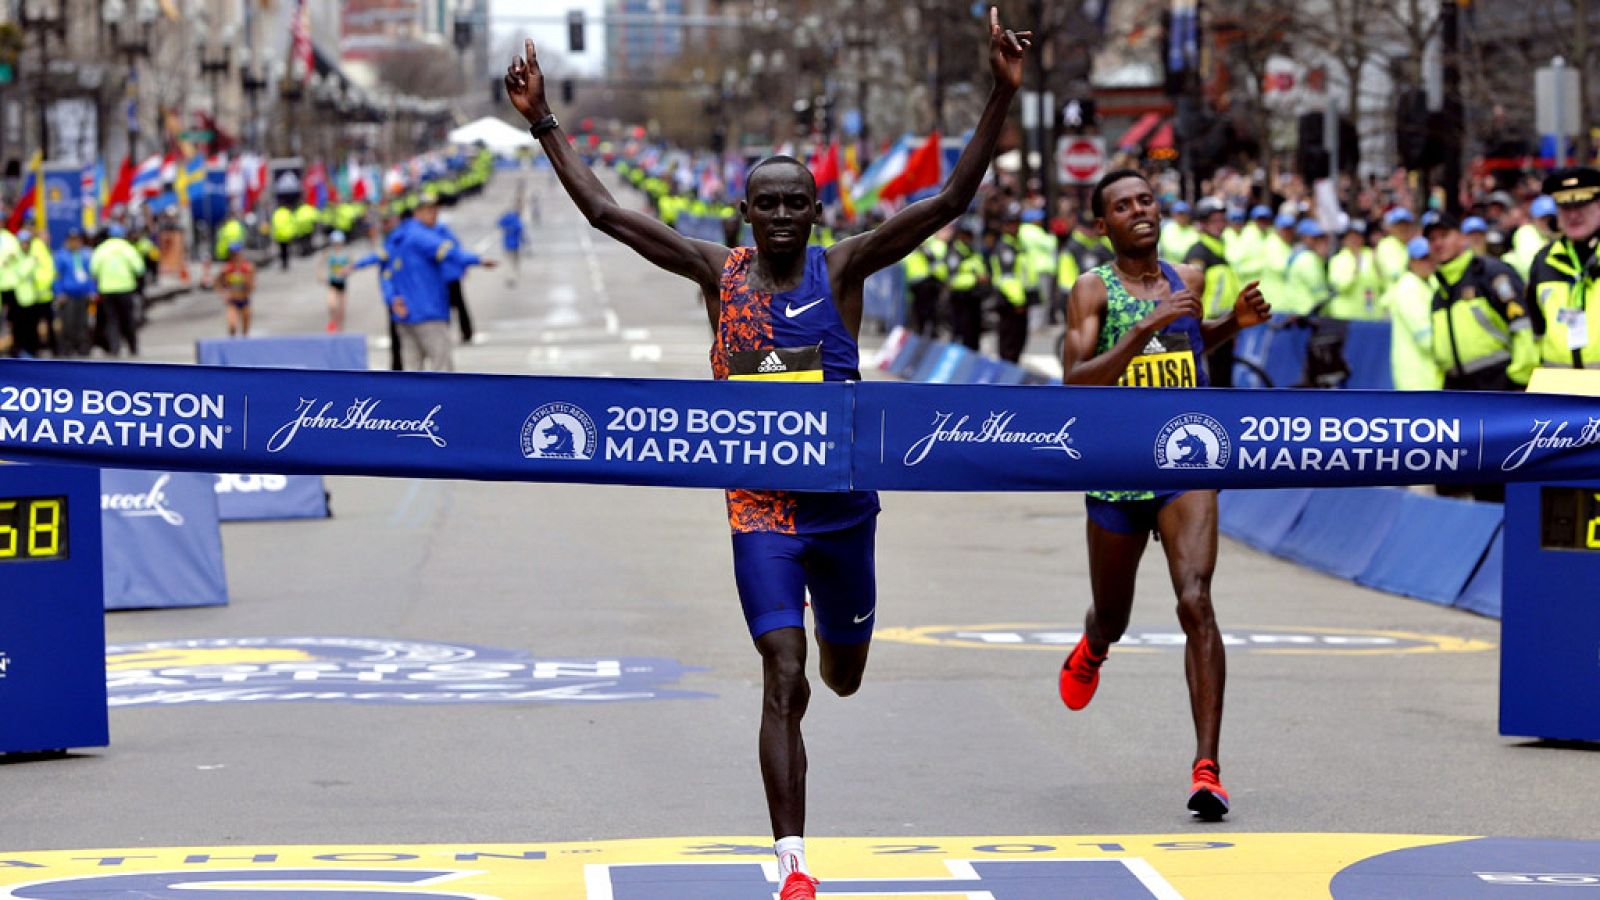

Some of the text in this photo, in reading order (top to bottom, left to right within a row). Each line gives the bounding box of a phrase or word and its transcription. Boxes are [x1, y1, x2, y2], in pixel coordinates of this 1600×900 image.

[0, 387, 225, 419] 2019 BOSTON
[0, 416, 224, 449] MARATHON
[267, 396, 447, 452] John Hancock
[607, 406, 828, 435] 2019 BOSTON
[1239, 416, 1460, 443] 2019 BOSTON
[605, 436, 826, 466] MARATHON
[903, 410, 1081, 467] John Hancock
[1501, 418, 1575, 471] John
[1238, 447, 1459, 471] MARATHON
[872, 841, 1235, 855] 2019
